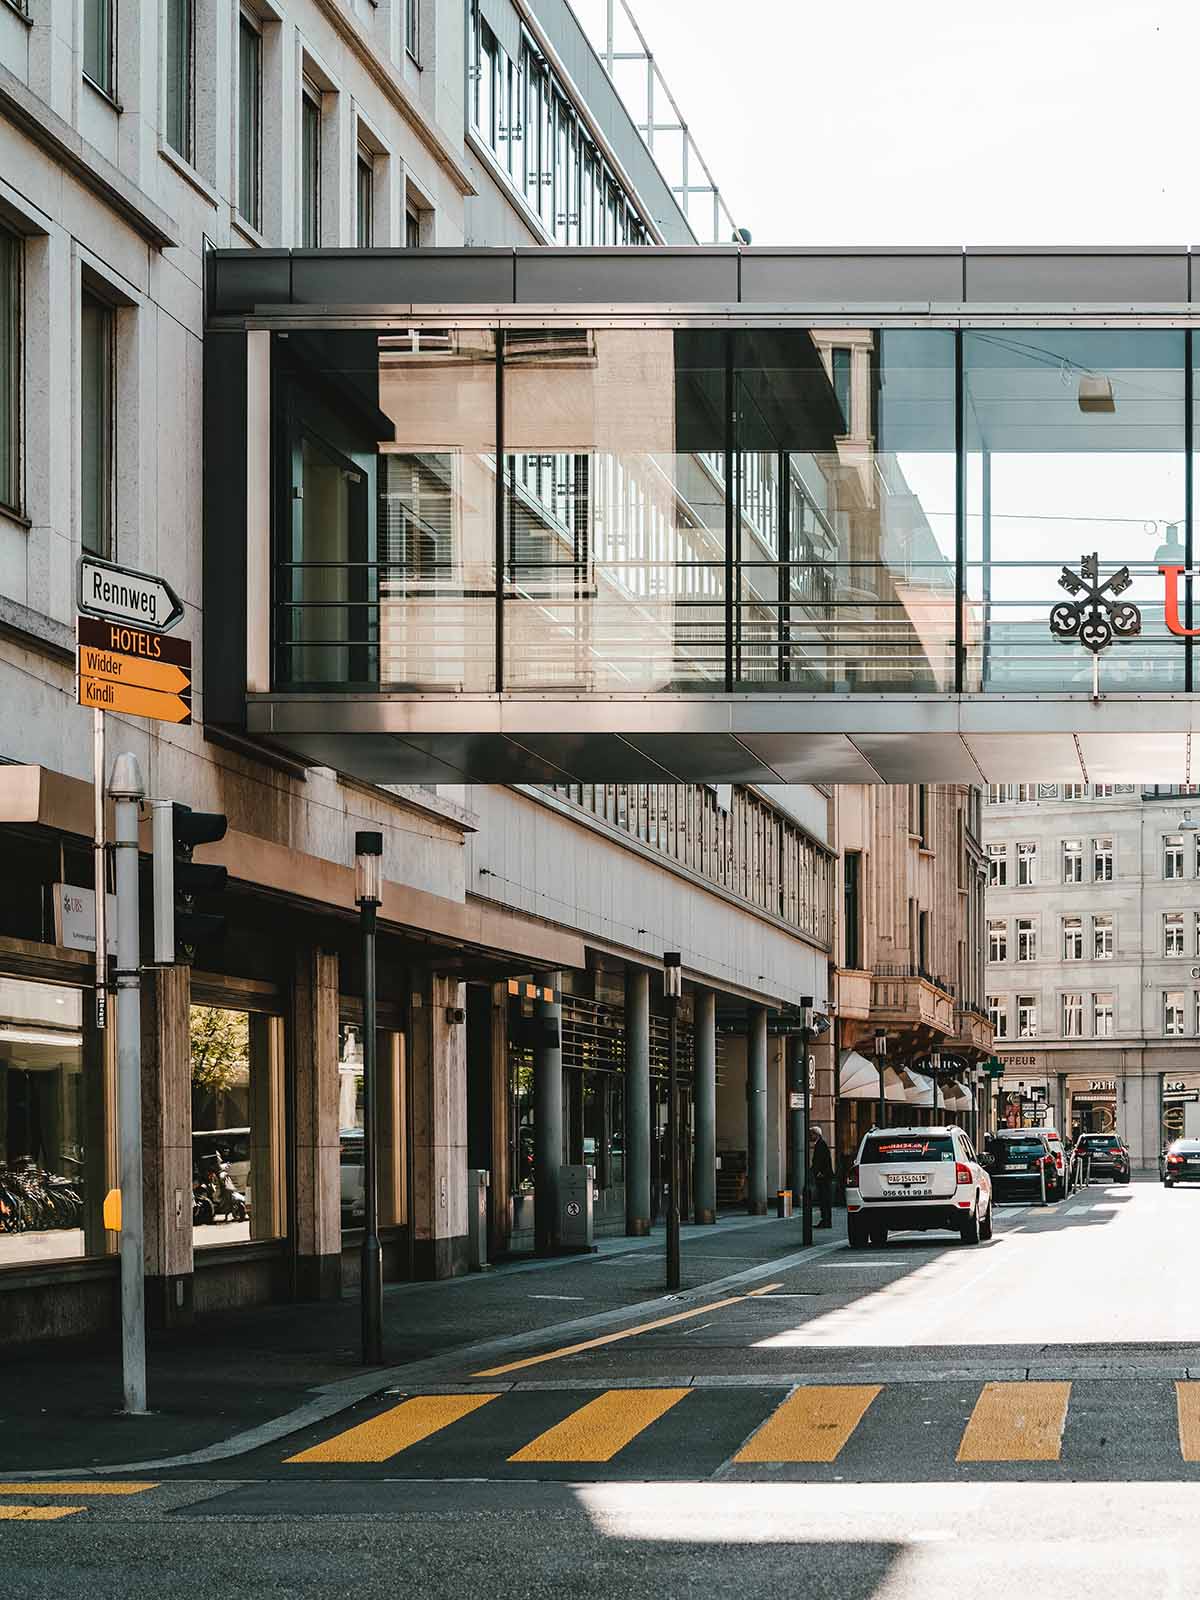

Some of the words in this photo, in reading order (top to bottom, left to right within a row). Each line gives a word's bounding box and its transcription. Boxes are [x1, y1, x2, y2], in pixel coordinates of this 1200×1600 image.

[93, 571, 157, 621] Rennweg
[111, 627, 161, 658] HOTELS
[86, 652, 122, 675] Widder
[86, 682, 114, 703] Kindli
